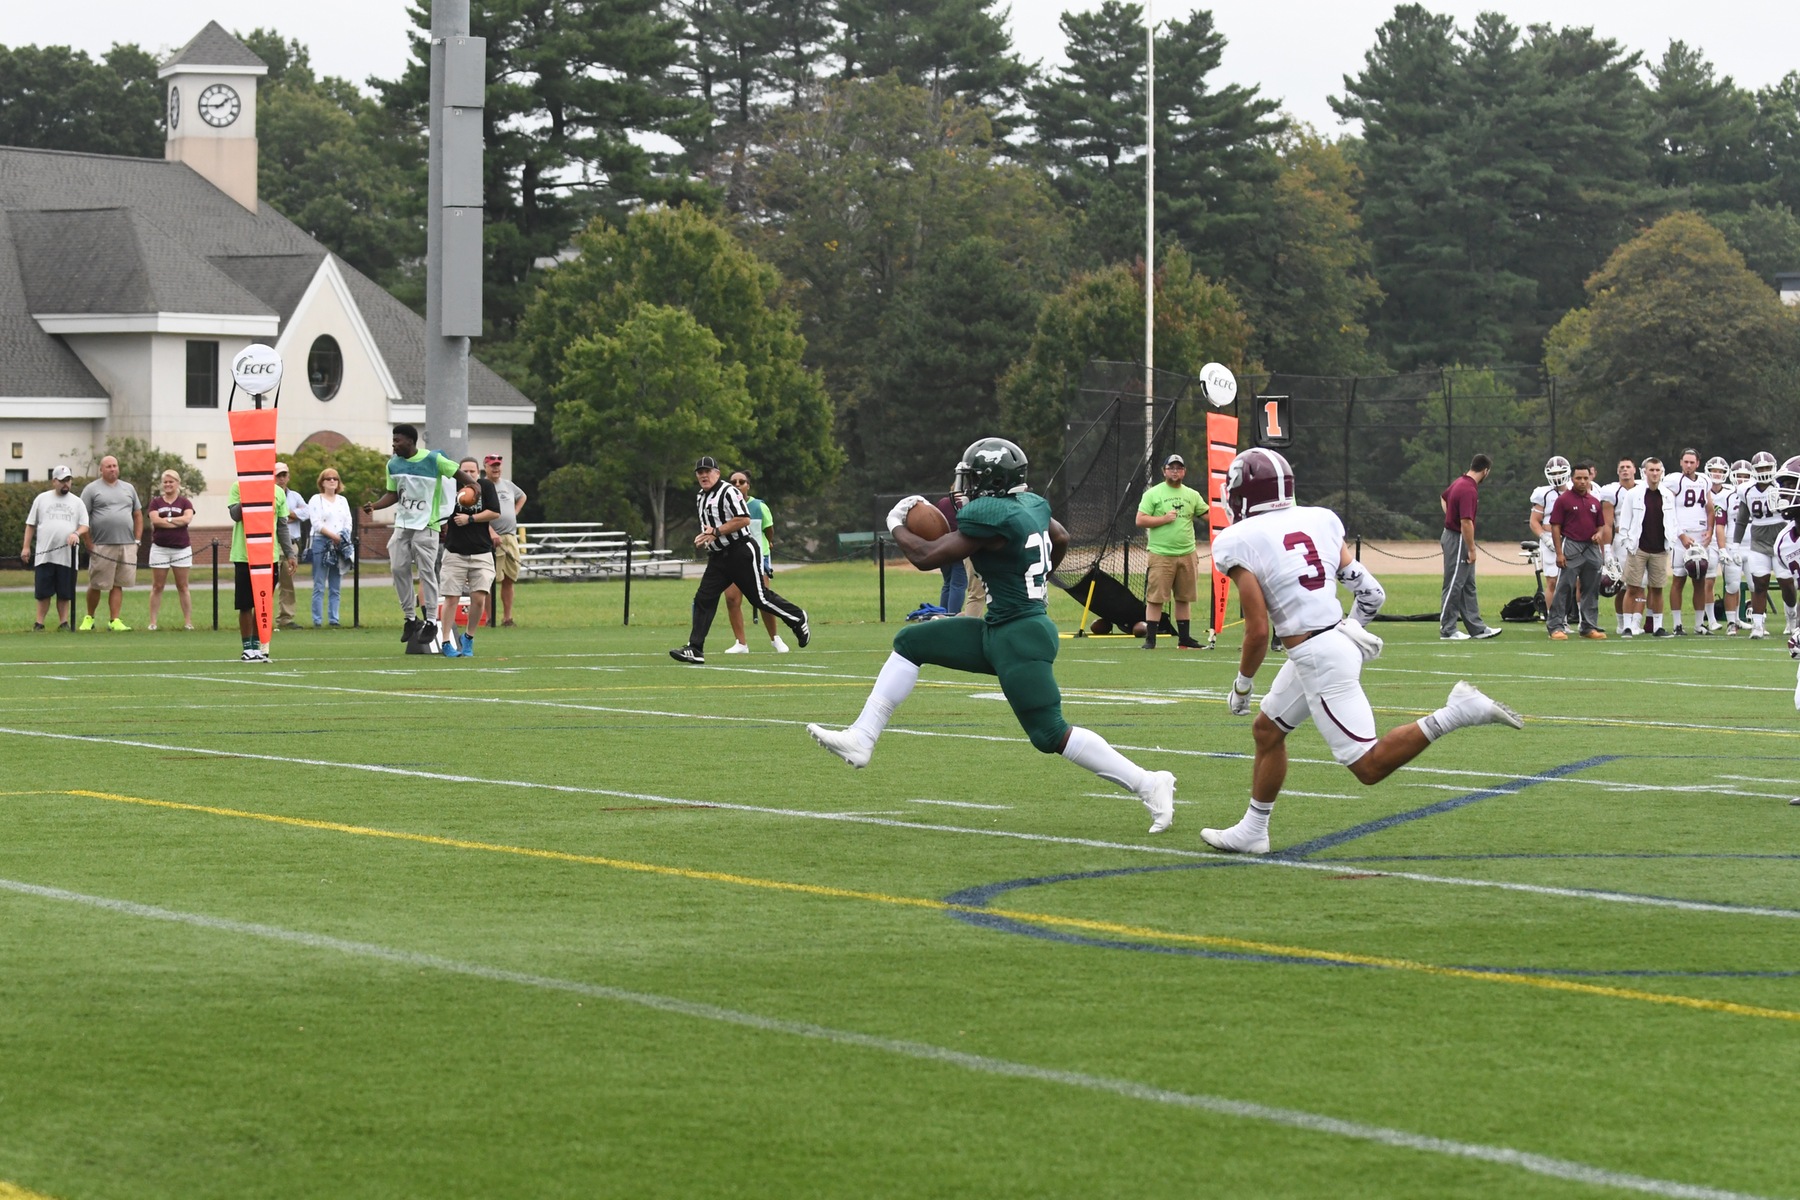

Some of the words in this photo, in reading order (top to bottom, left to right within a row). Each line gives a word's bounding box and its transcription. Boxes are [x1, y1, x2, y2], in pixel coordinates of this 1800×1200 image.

[244, 363, 276, 375] ECFC
[1213, 377, 1235, 391] ECFC
[1264, 401, 1283, 437] 1
[1684, 489, 1706, 508] 84
[1283, 531, 1326, 592] 3
